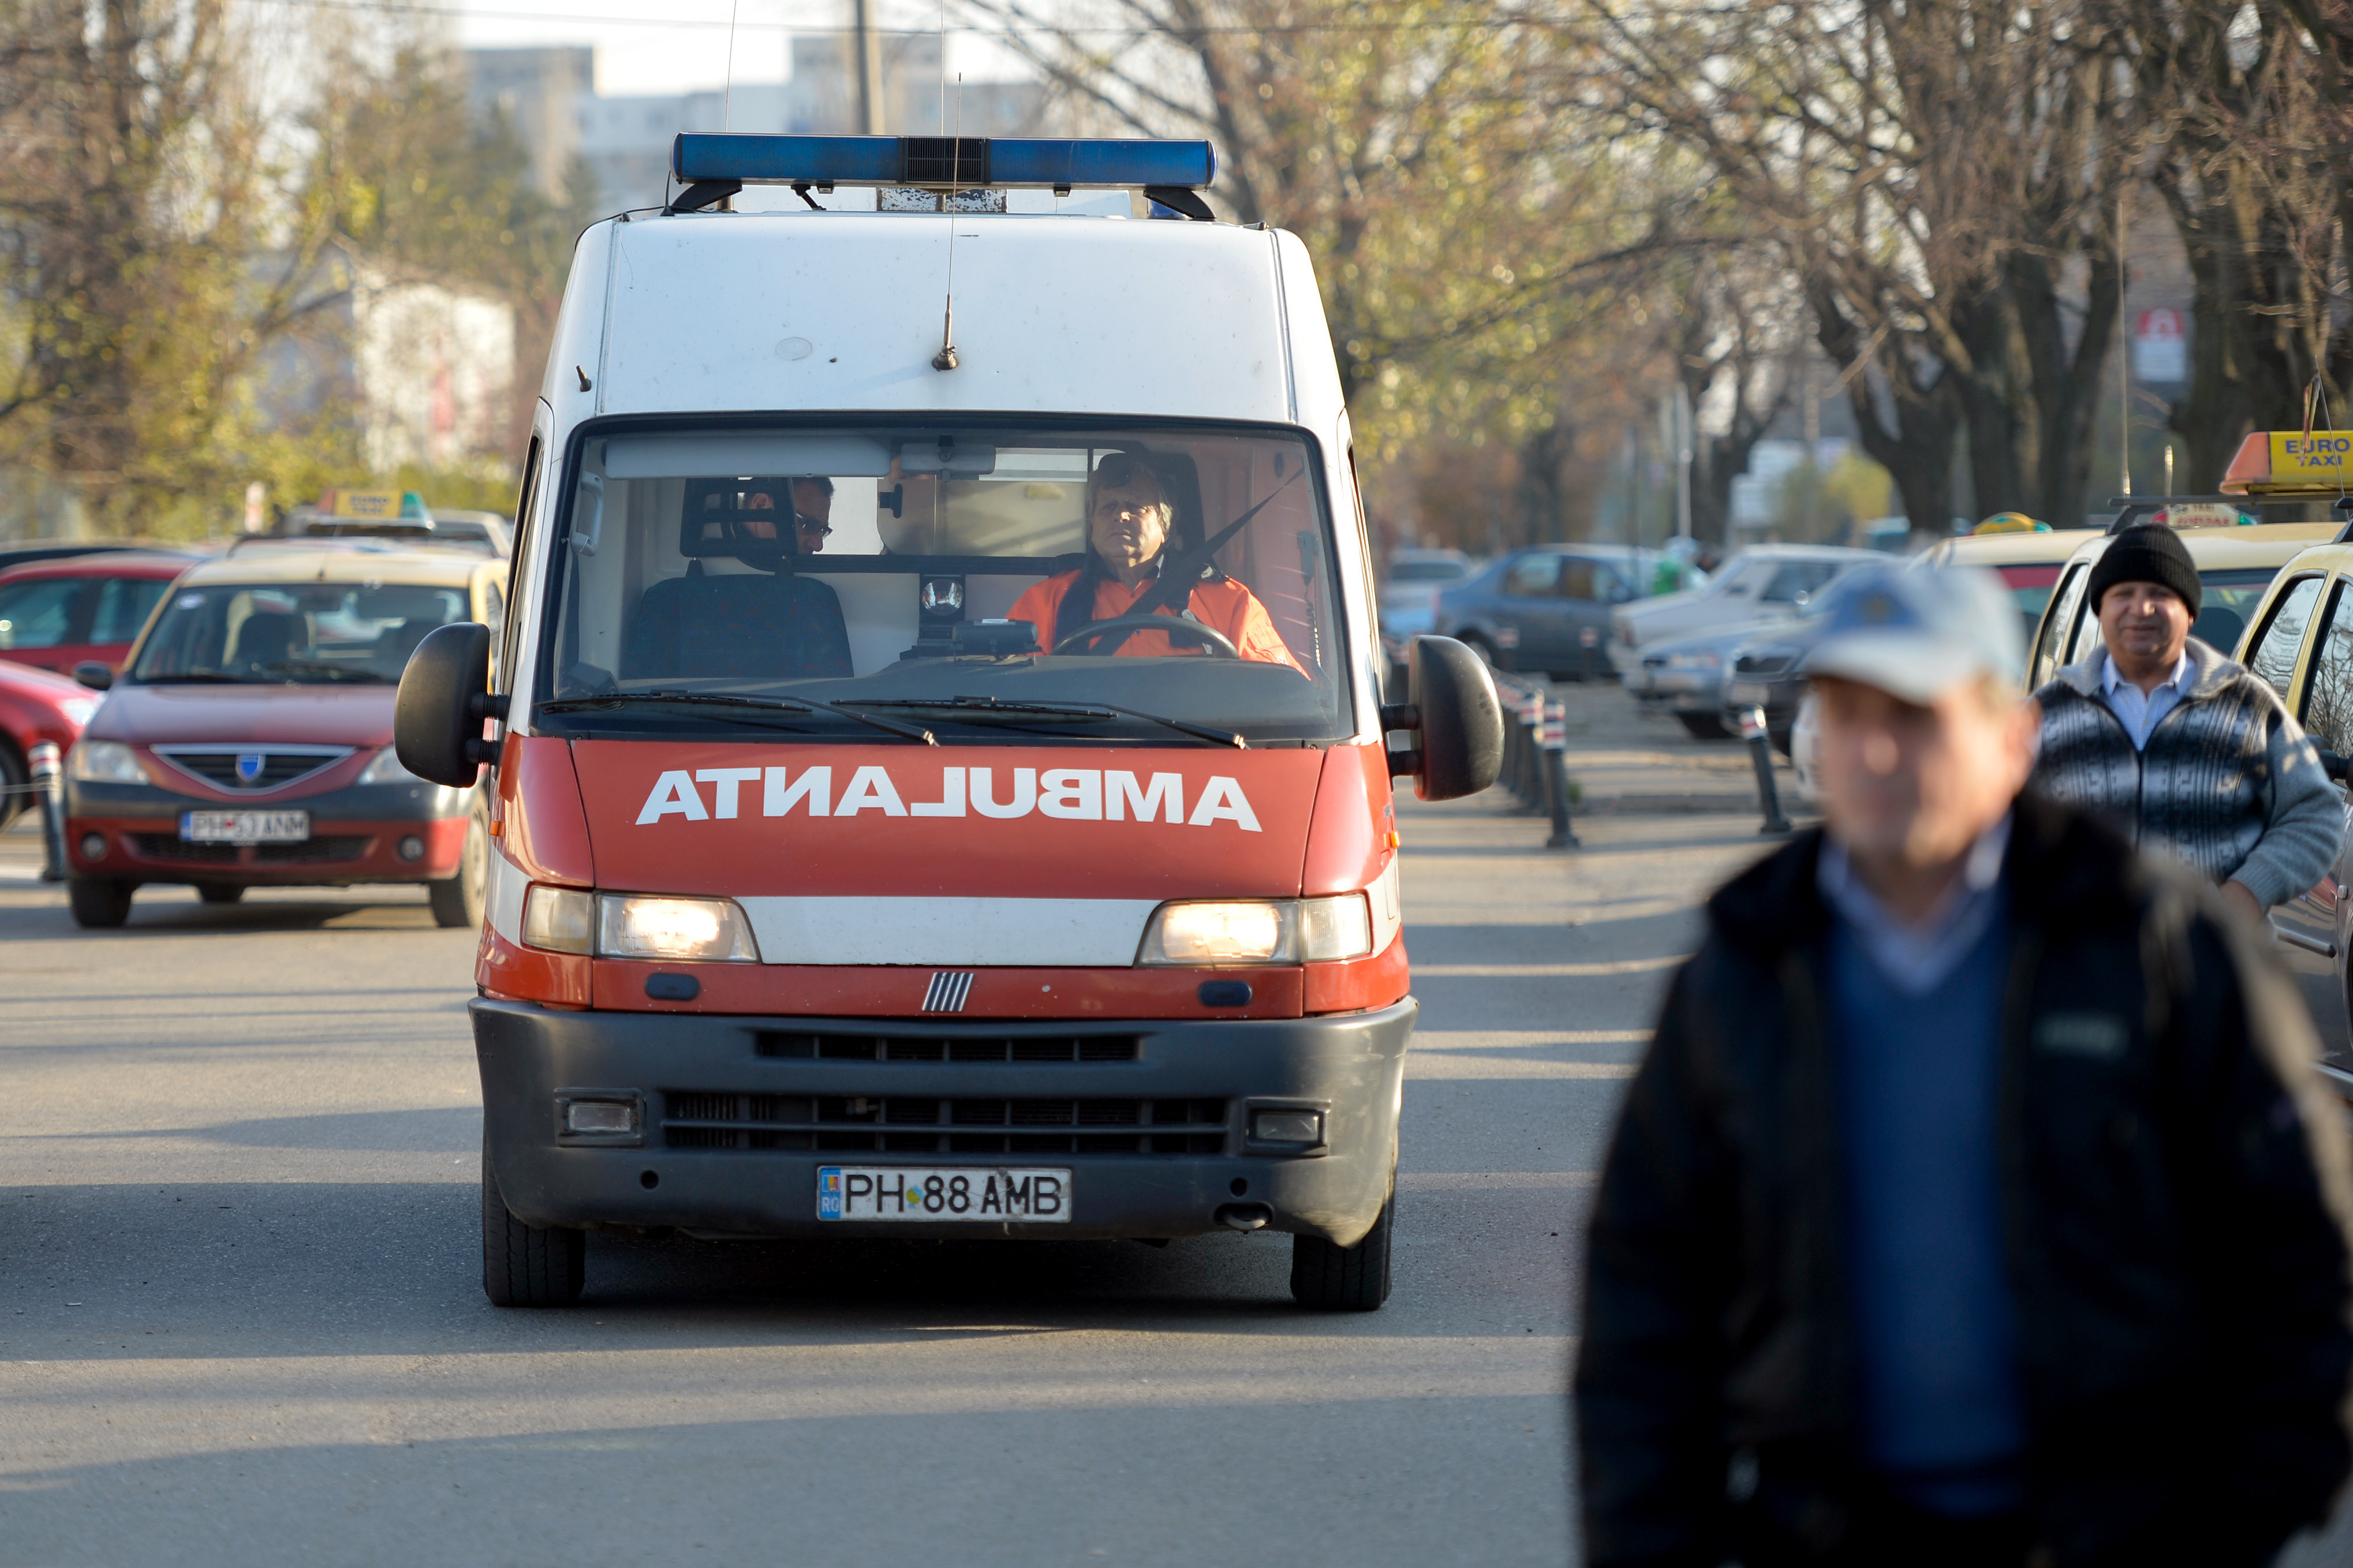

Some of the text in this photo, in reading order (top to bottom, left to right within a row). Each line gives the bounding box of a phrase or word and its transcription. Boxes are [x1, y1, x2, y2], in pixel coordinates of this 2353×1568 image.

[2286, 438, 2351, 454] EURO
[2295, 455, 2343, 466] TAXI
[845, 1174, 1062, 1214] PH 88 AMB
[822, 1197, 839, 1213] RO
